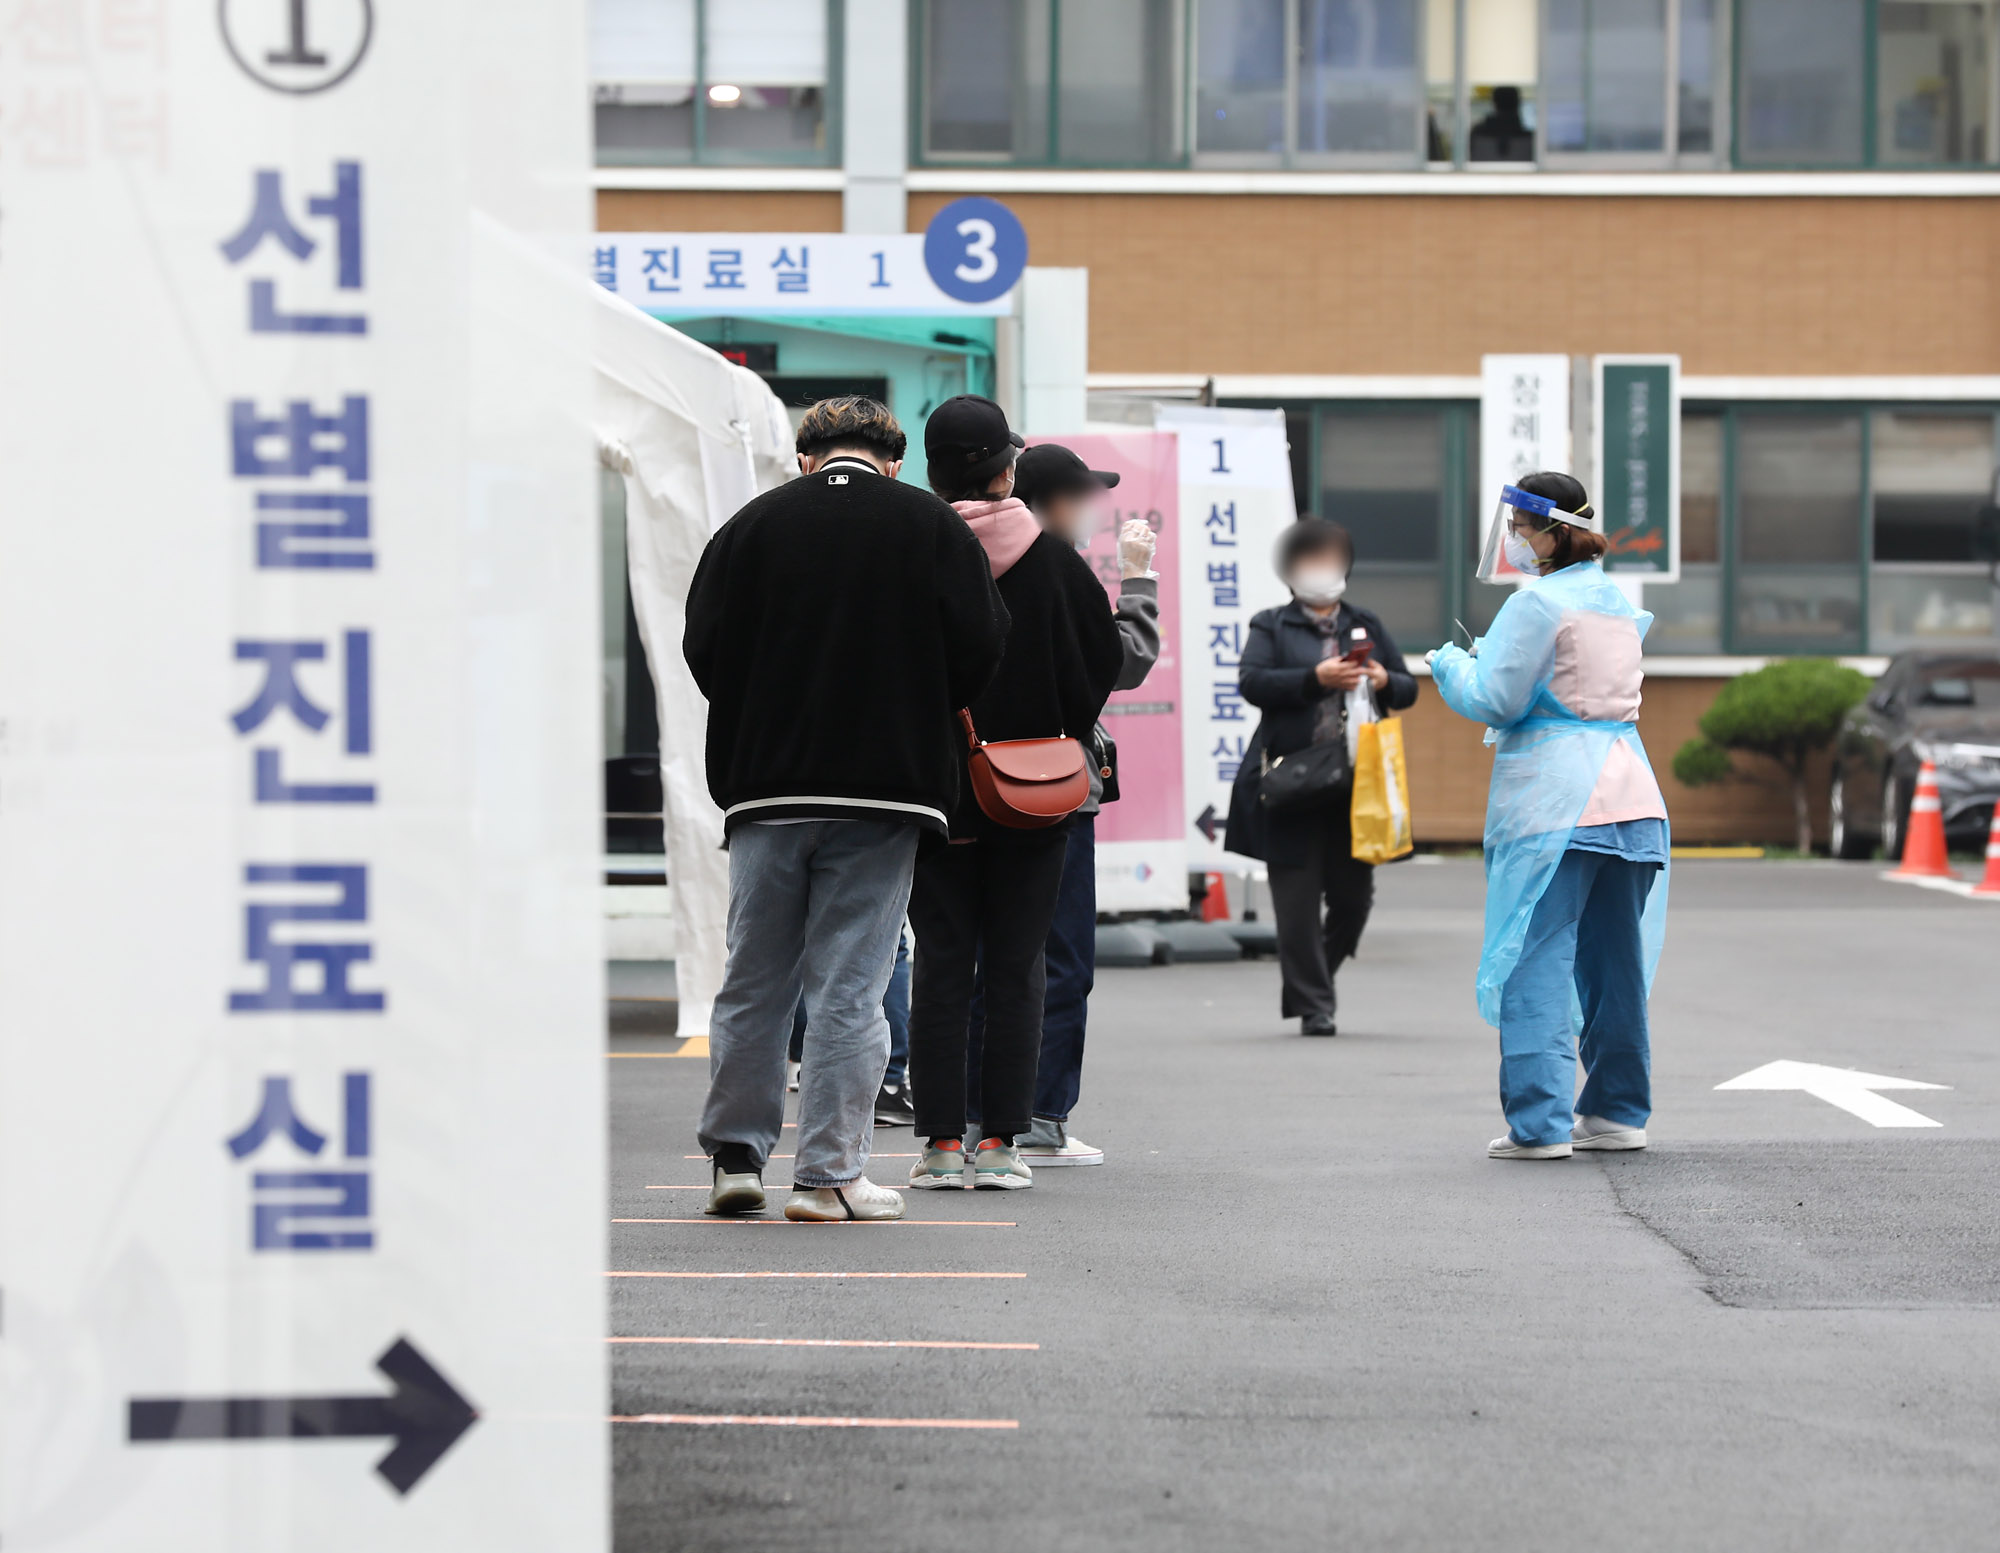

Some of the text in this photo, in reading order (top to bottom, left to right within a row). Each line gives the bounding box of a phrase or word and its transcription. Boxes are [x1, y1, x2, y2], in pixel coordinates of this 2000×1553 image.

[869, 251, 891, 288] 1
[954, 217, 998, 283] 3
[1211, 438, 1231, 474] 1
[1204, 501, 1250, 783] 선별진료실
[218, 159, 386, 1253] 선별진료실
